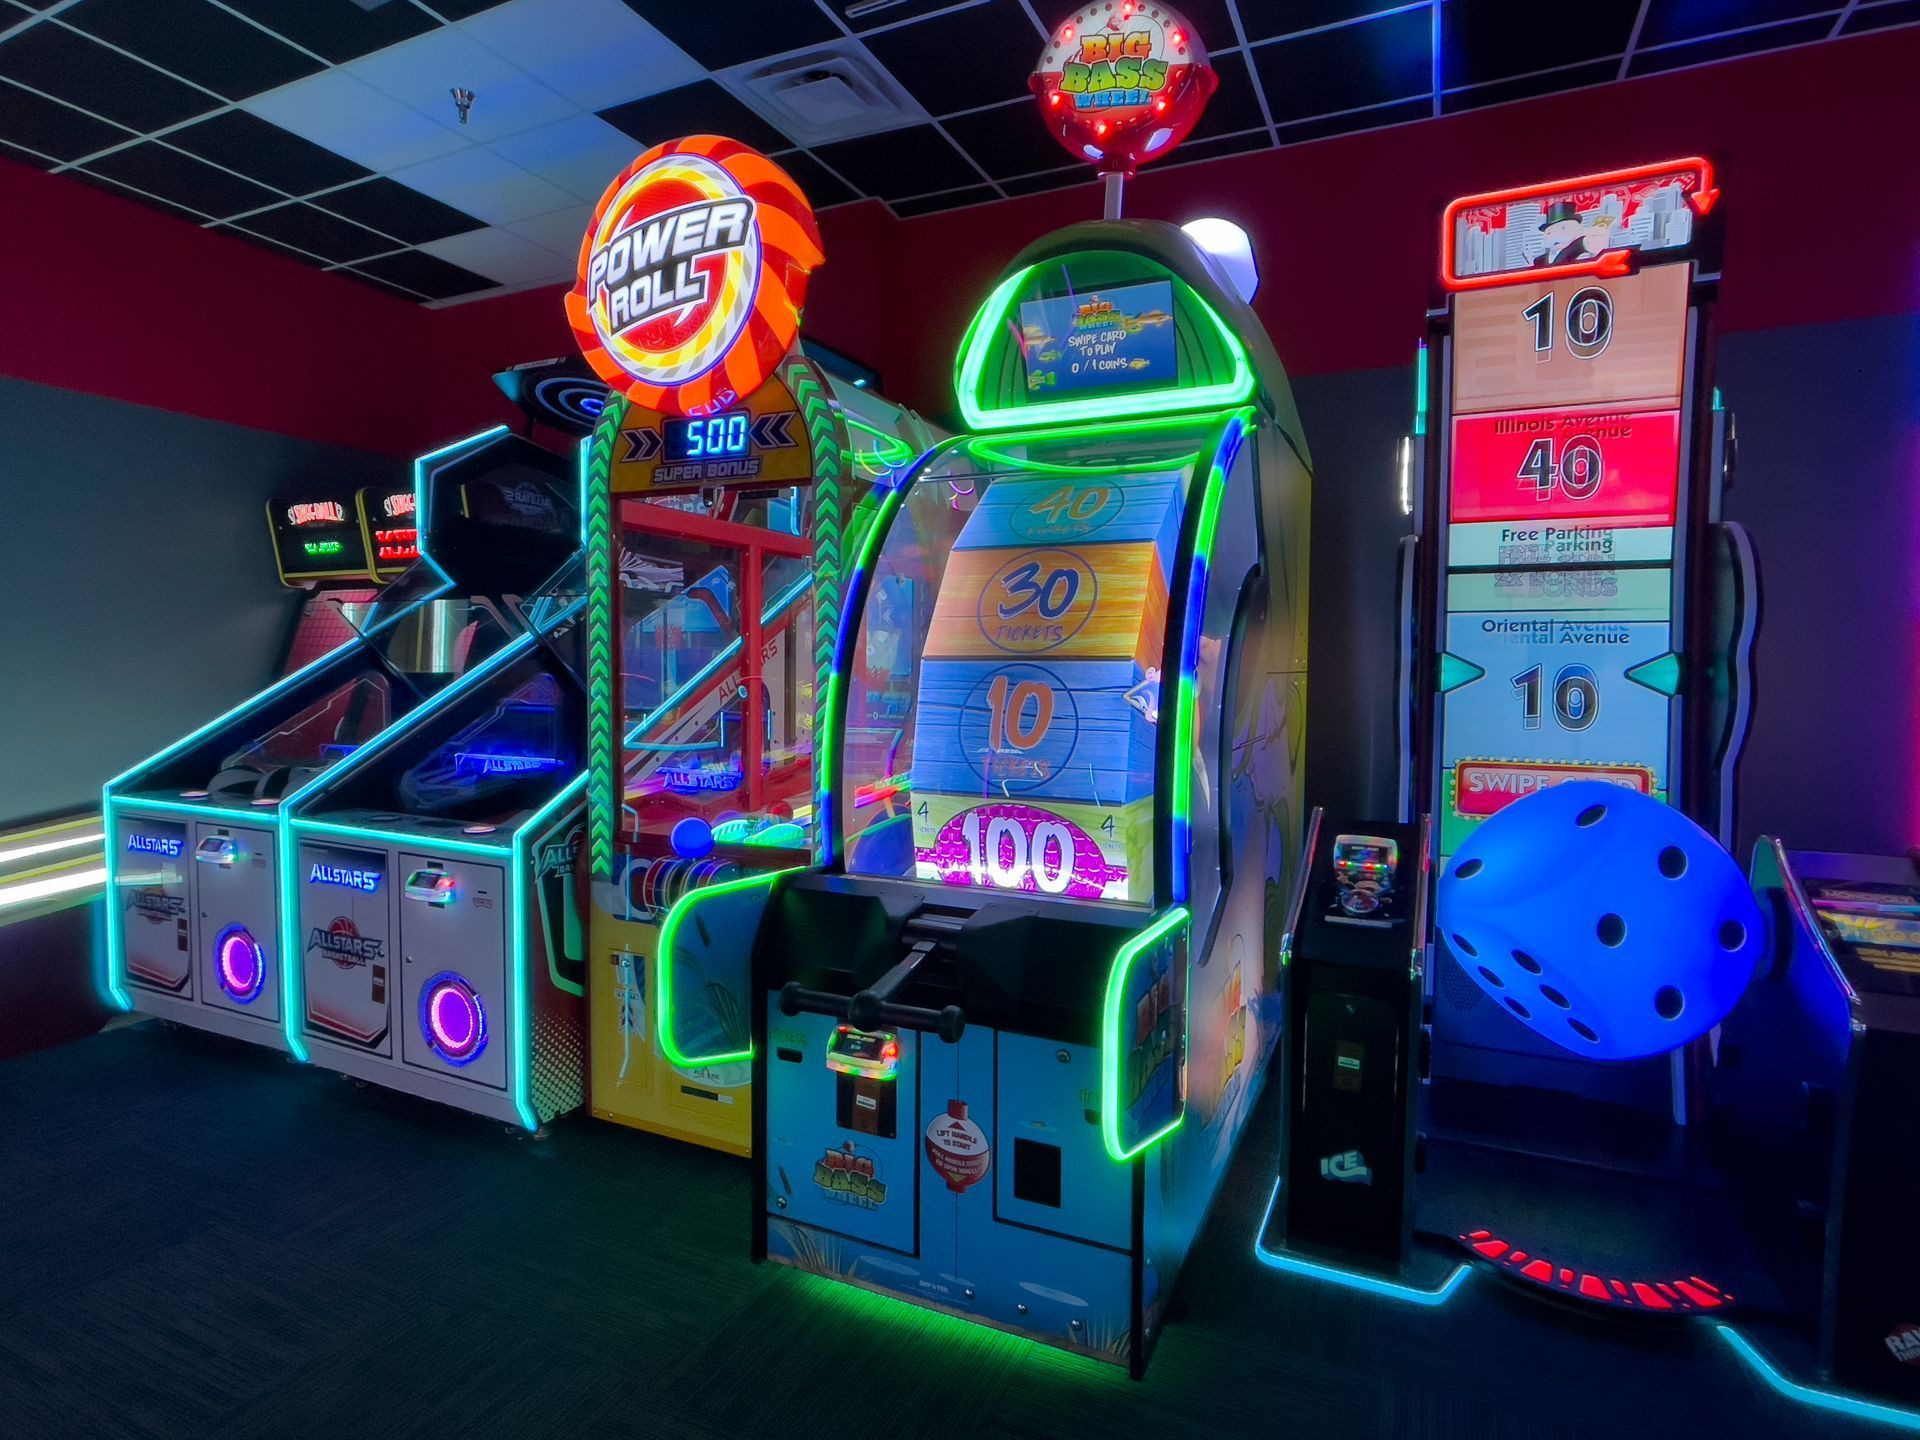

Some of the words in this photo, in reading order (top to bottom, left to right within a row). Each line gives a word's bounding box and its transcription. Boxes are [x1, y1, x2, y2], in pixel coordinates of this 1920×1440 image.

[1080, 31, 1152, 63] BIG
[1058, 57, 1169, 93] BASS
[1072, 90, 1153, 108] WHEEL
[590, 203, 750, 298] POWER
[611, 261, 706, 329] ROLL
[1522, 286, 1614, 360] 10
[1068, 334, 1098, 347] SWIPE
[1100, 330, 1127, 341] CARD
[1080, 346, 1093, 357] TO
[1095, 342, 1118, 355] PLAY
[1099, 358, 1129, 370] COINS
[686, 414, 747, 456] 500
[1495, 417, 1557, 434] Illinois
[654, 464, 701, 483] SUPER
[706, 459, 761, 480] BONUS
[1516, 434, 1604, 500] 40
[1028, 486, 1111, 524] 40
[1501, 528, 1539, 542] Free
[1545, 525, 1613, 548] Parking
[998, 561, 1079, 621] 30
[996, 623, 1065, 642] TICKETS
[1481, 618, 1554, 637] Oriental
[1559, 625, 1631, 644] Avenue
[1511, 663, 1600, 733] 10
[987, 675, 1054, 752] 10
[663, 772, 735, 789] ALLSTARS
[1468, 772, 1550, 794] SWIPE
[917, 800, 929, 824] 4
[1100, 814, 1115, 838] 4
[128, 834, 182, 855] ALLSTARS
[962, 812, 1075, 893] 100
[310, 863, 381, 889] ALLSTARS
[307, 927, 383, 960] ALLSTARS
[935, 1129, 951, 1138] LIFT
[952, 1140, 972, 1151] START
[825, 1148, 874, 1178] BIG
[1320, 1150, 1368, 1177] ICE
[813, 1161, 888, 1204] BASS
